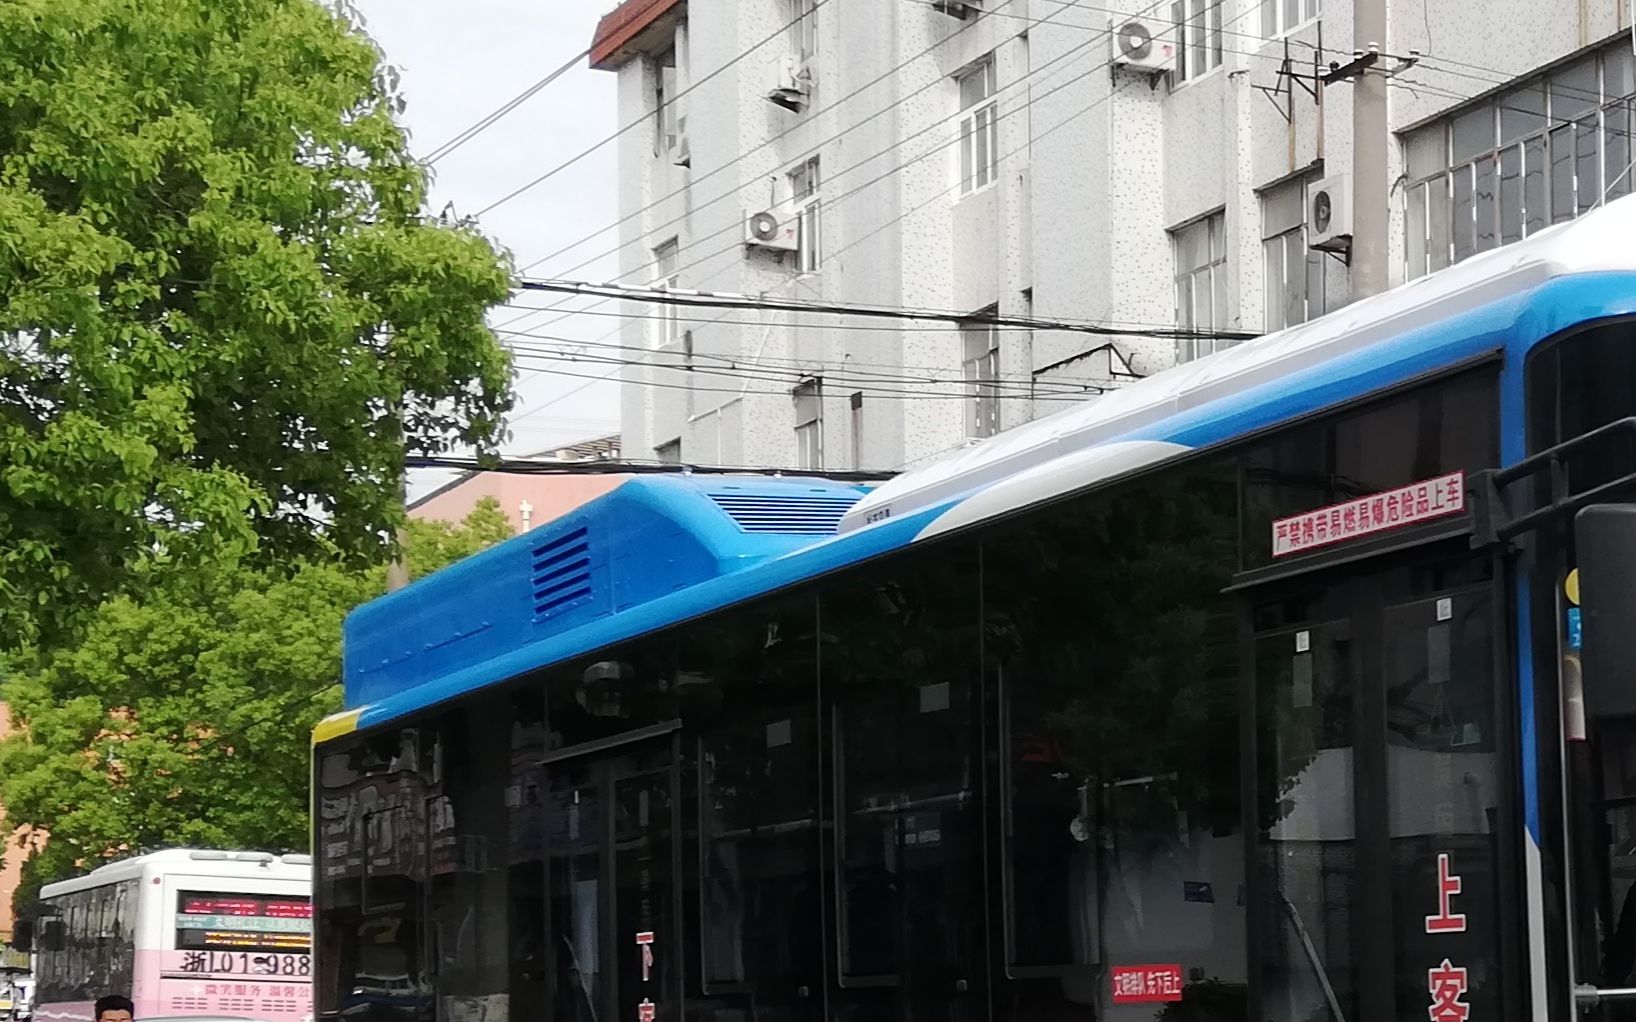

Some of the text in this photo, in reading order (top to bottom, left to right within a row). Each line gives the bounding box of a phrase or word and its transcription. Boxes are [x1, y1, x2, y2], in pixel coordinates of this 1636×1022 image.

[1276, 478, 1460, 550] 严禁携带易燃易爆危险品上车
